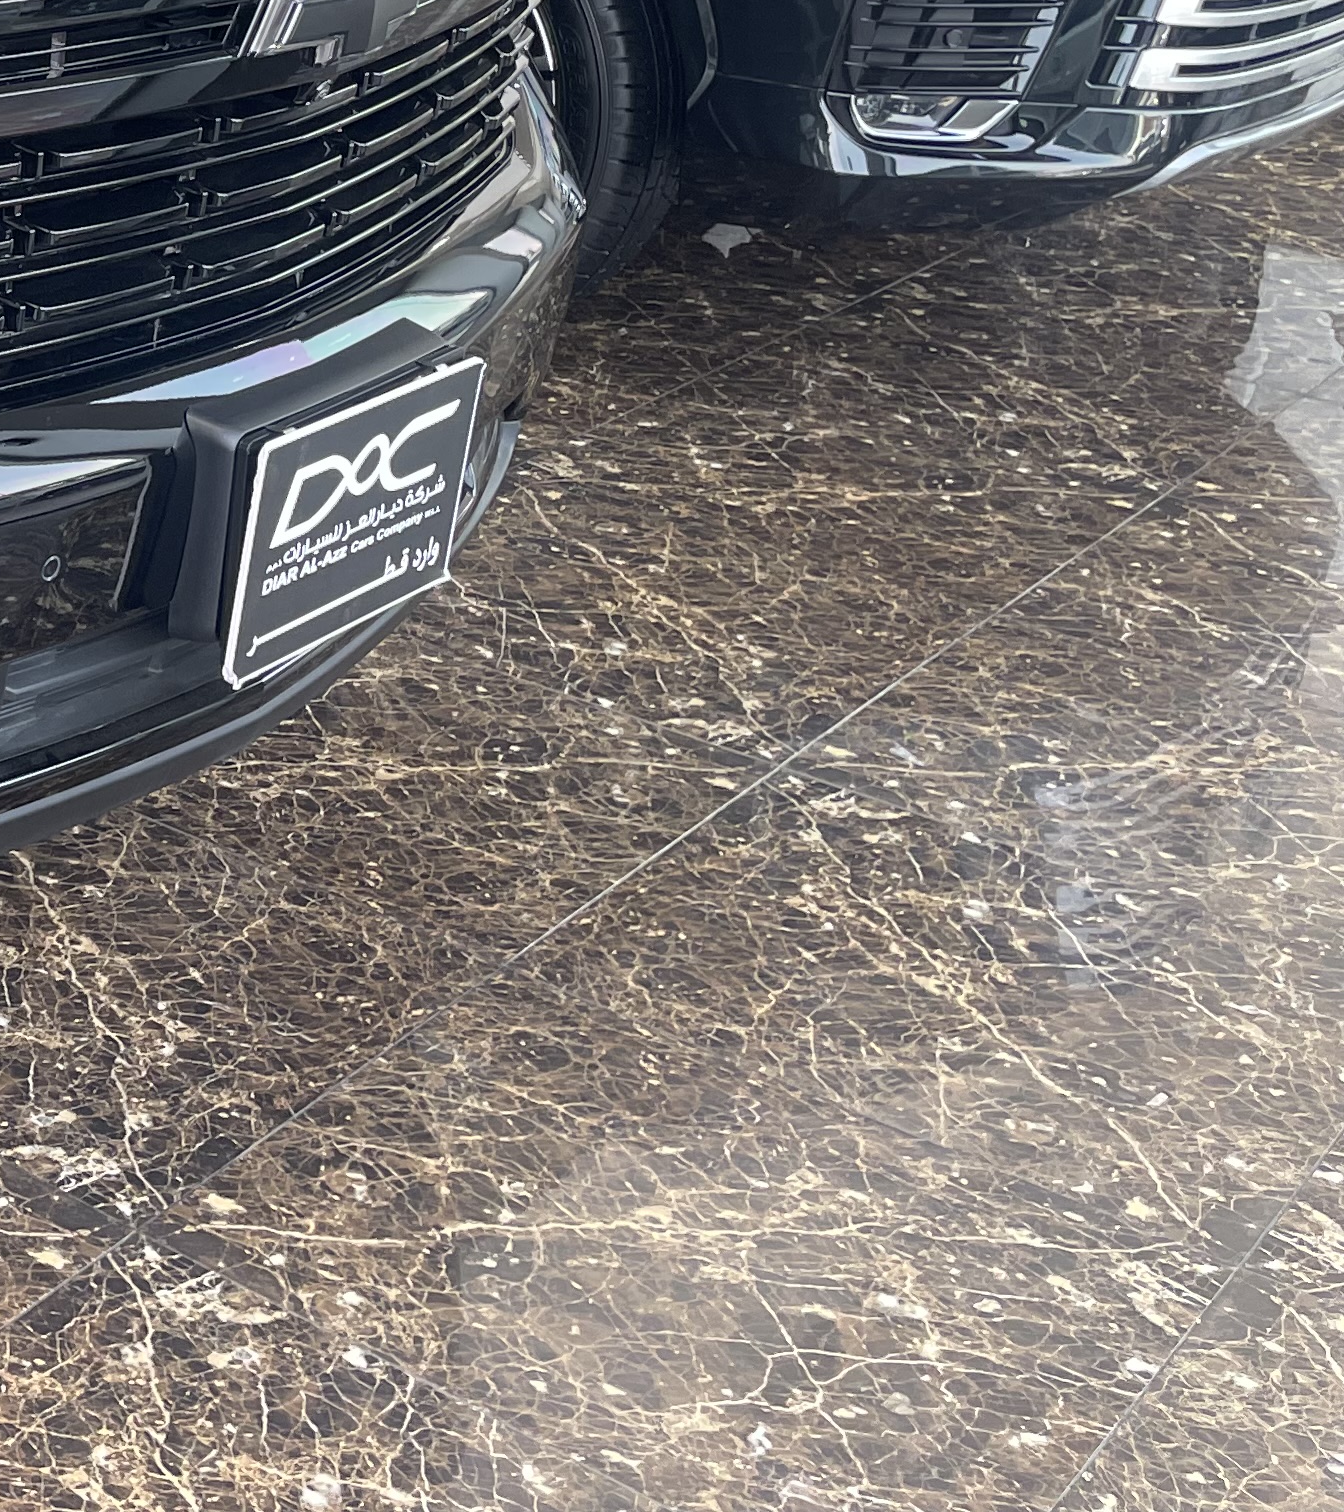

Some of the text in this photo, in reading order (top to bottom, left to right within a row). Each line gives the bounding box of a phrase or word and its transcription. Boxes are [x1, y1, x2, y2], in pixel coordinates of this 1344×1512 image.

[404, 473, 447, 508] شركة
[261, 565, 299, 597] DIAR
[350, 534, 375, 554] Cars
[375, 510, 425, 542] Company
